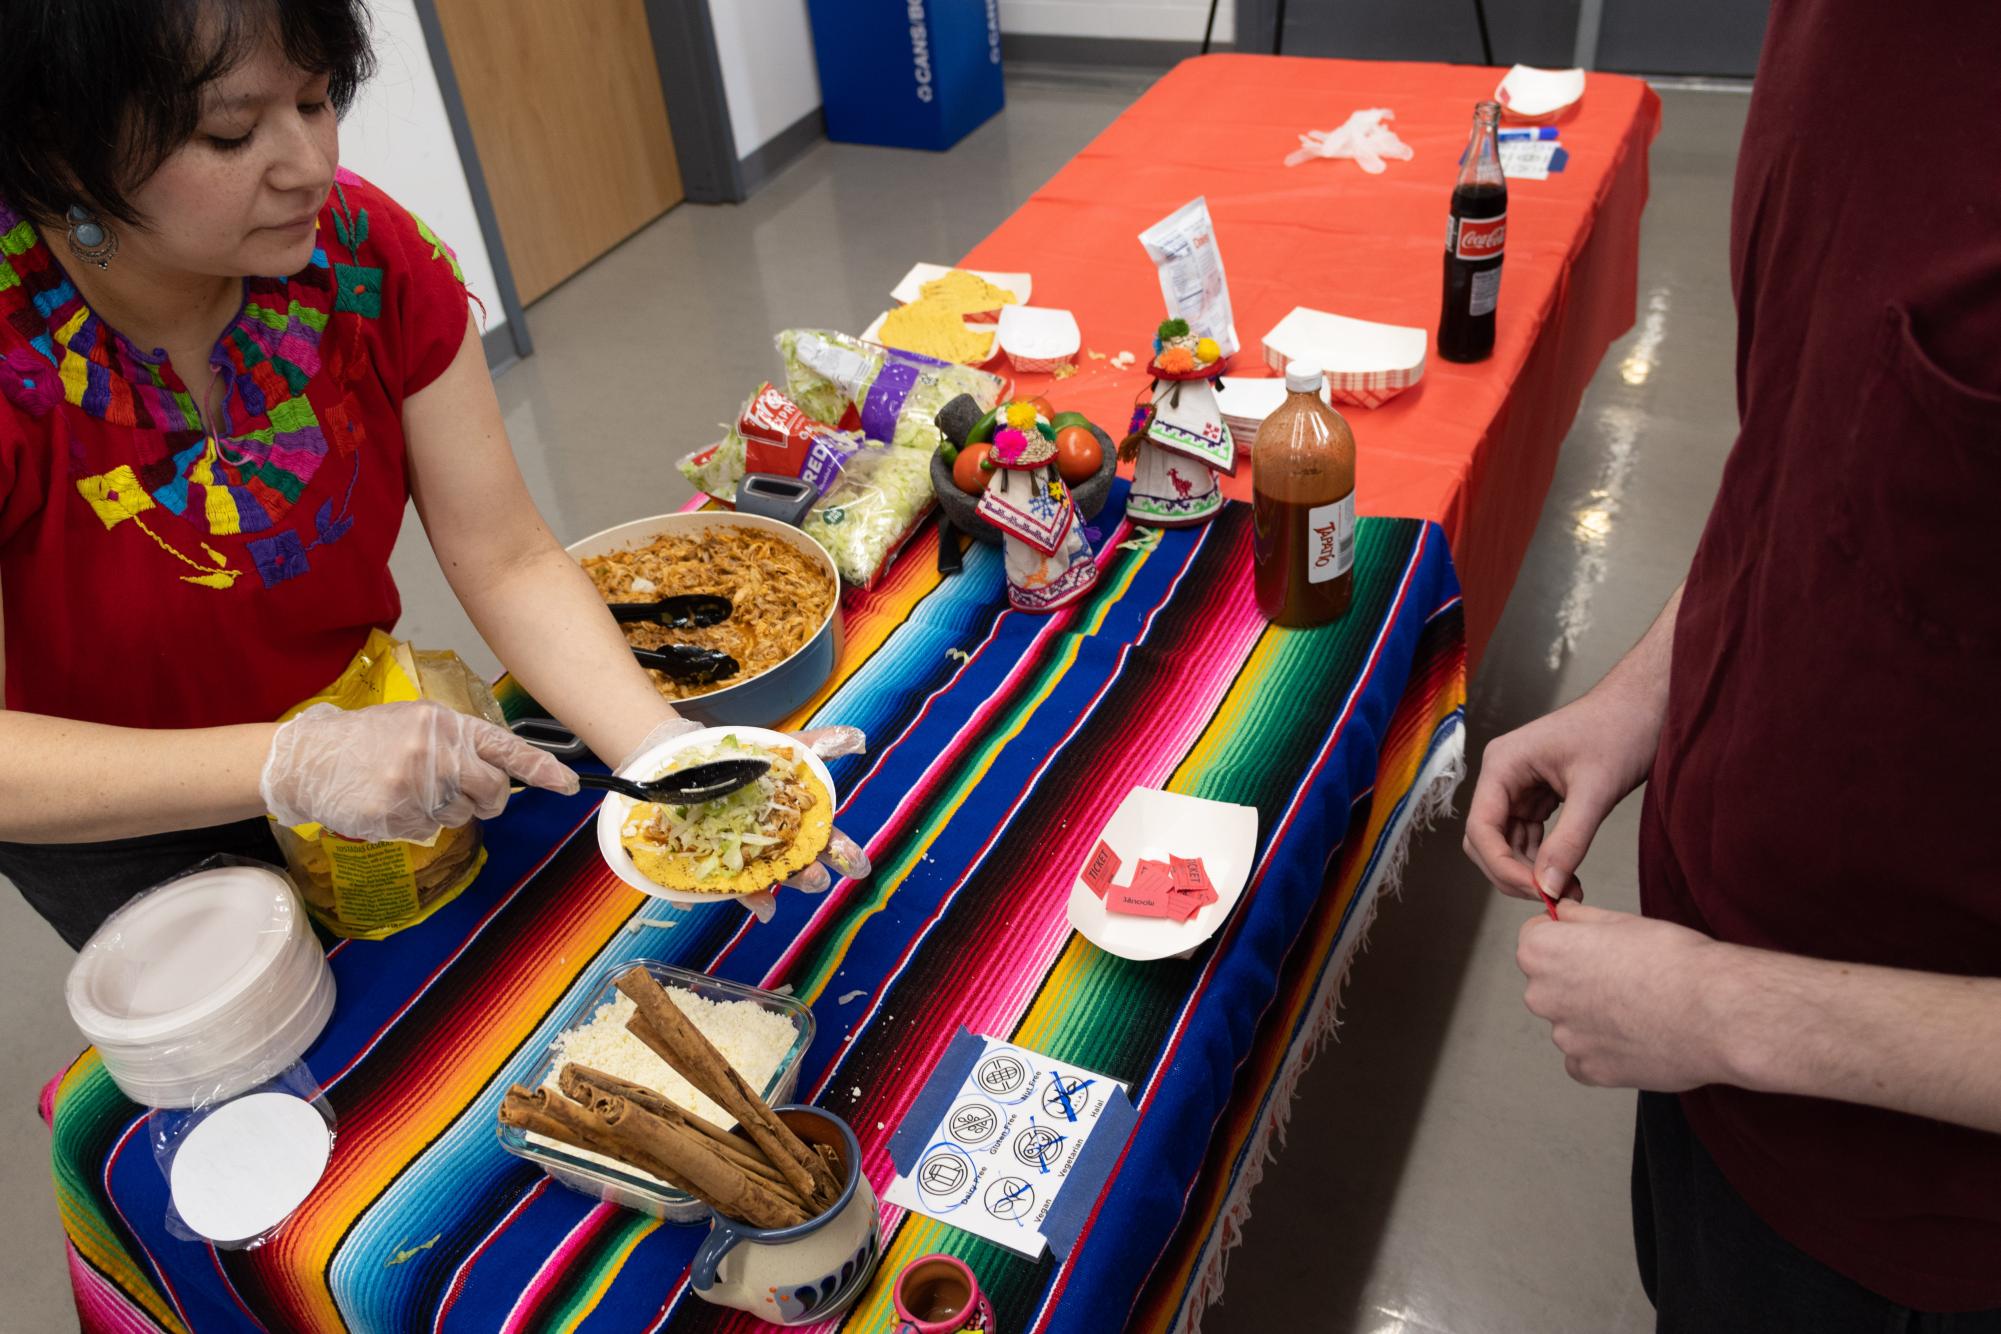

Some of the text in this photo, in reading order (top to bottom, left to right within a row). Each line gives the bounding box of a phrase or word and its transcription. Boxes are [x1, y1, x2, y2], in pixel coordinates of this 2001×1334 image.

[1088, 849, 1109, 880] TICKET
[1020, 1071, 1042, 1101] Nut Free
[1090, 1099, 1105, 1118] Halal
[989, 1113, 1018, 1155] Gluten Free
[1057, 1138, 1084, 1178] Vegetarian
[960, 1166, 988, 1206] Dairy Free
[1034, 1198, 1052, 1222] Vegan
